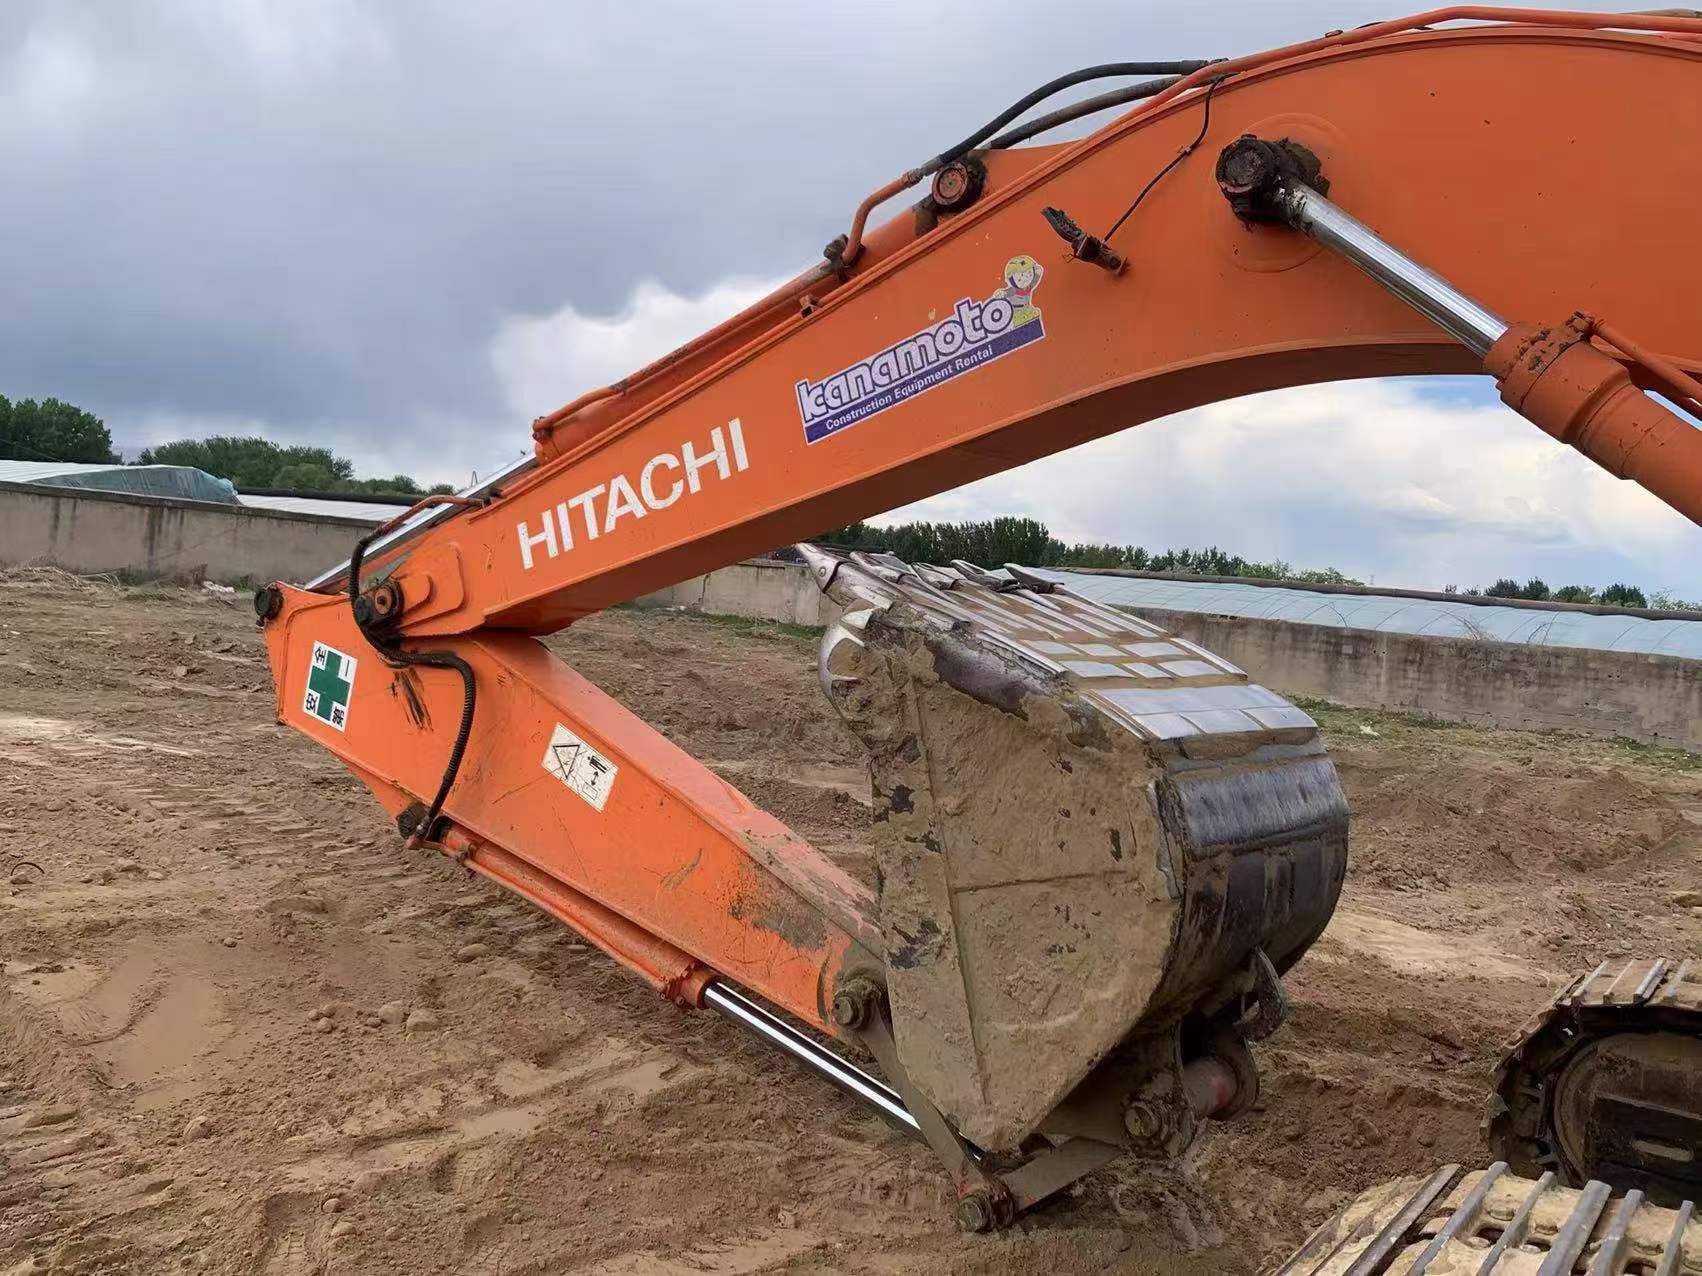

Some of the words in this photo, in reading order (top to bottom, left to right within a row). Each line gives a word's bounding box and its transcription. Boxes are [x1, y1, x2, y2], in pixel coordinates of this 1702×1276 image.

[797, 297, 1014, 422] kanamoto
[825, 392, 892, 431] Construction
[895, 364, 953, 400] Equipment
[955, 344, 994, 371] Rental
[517, 417, 749, 570] HITACHI
